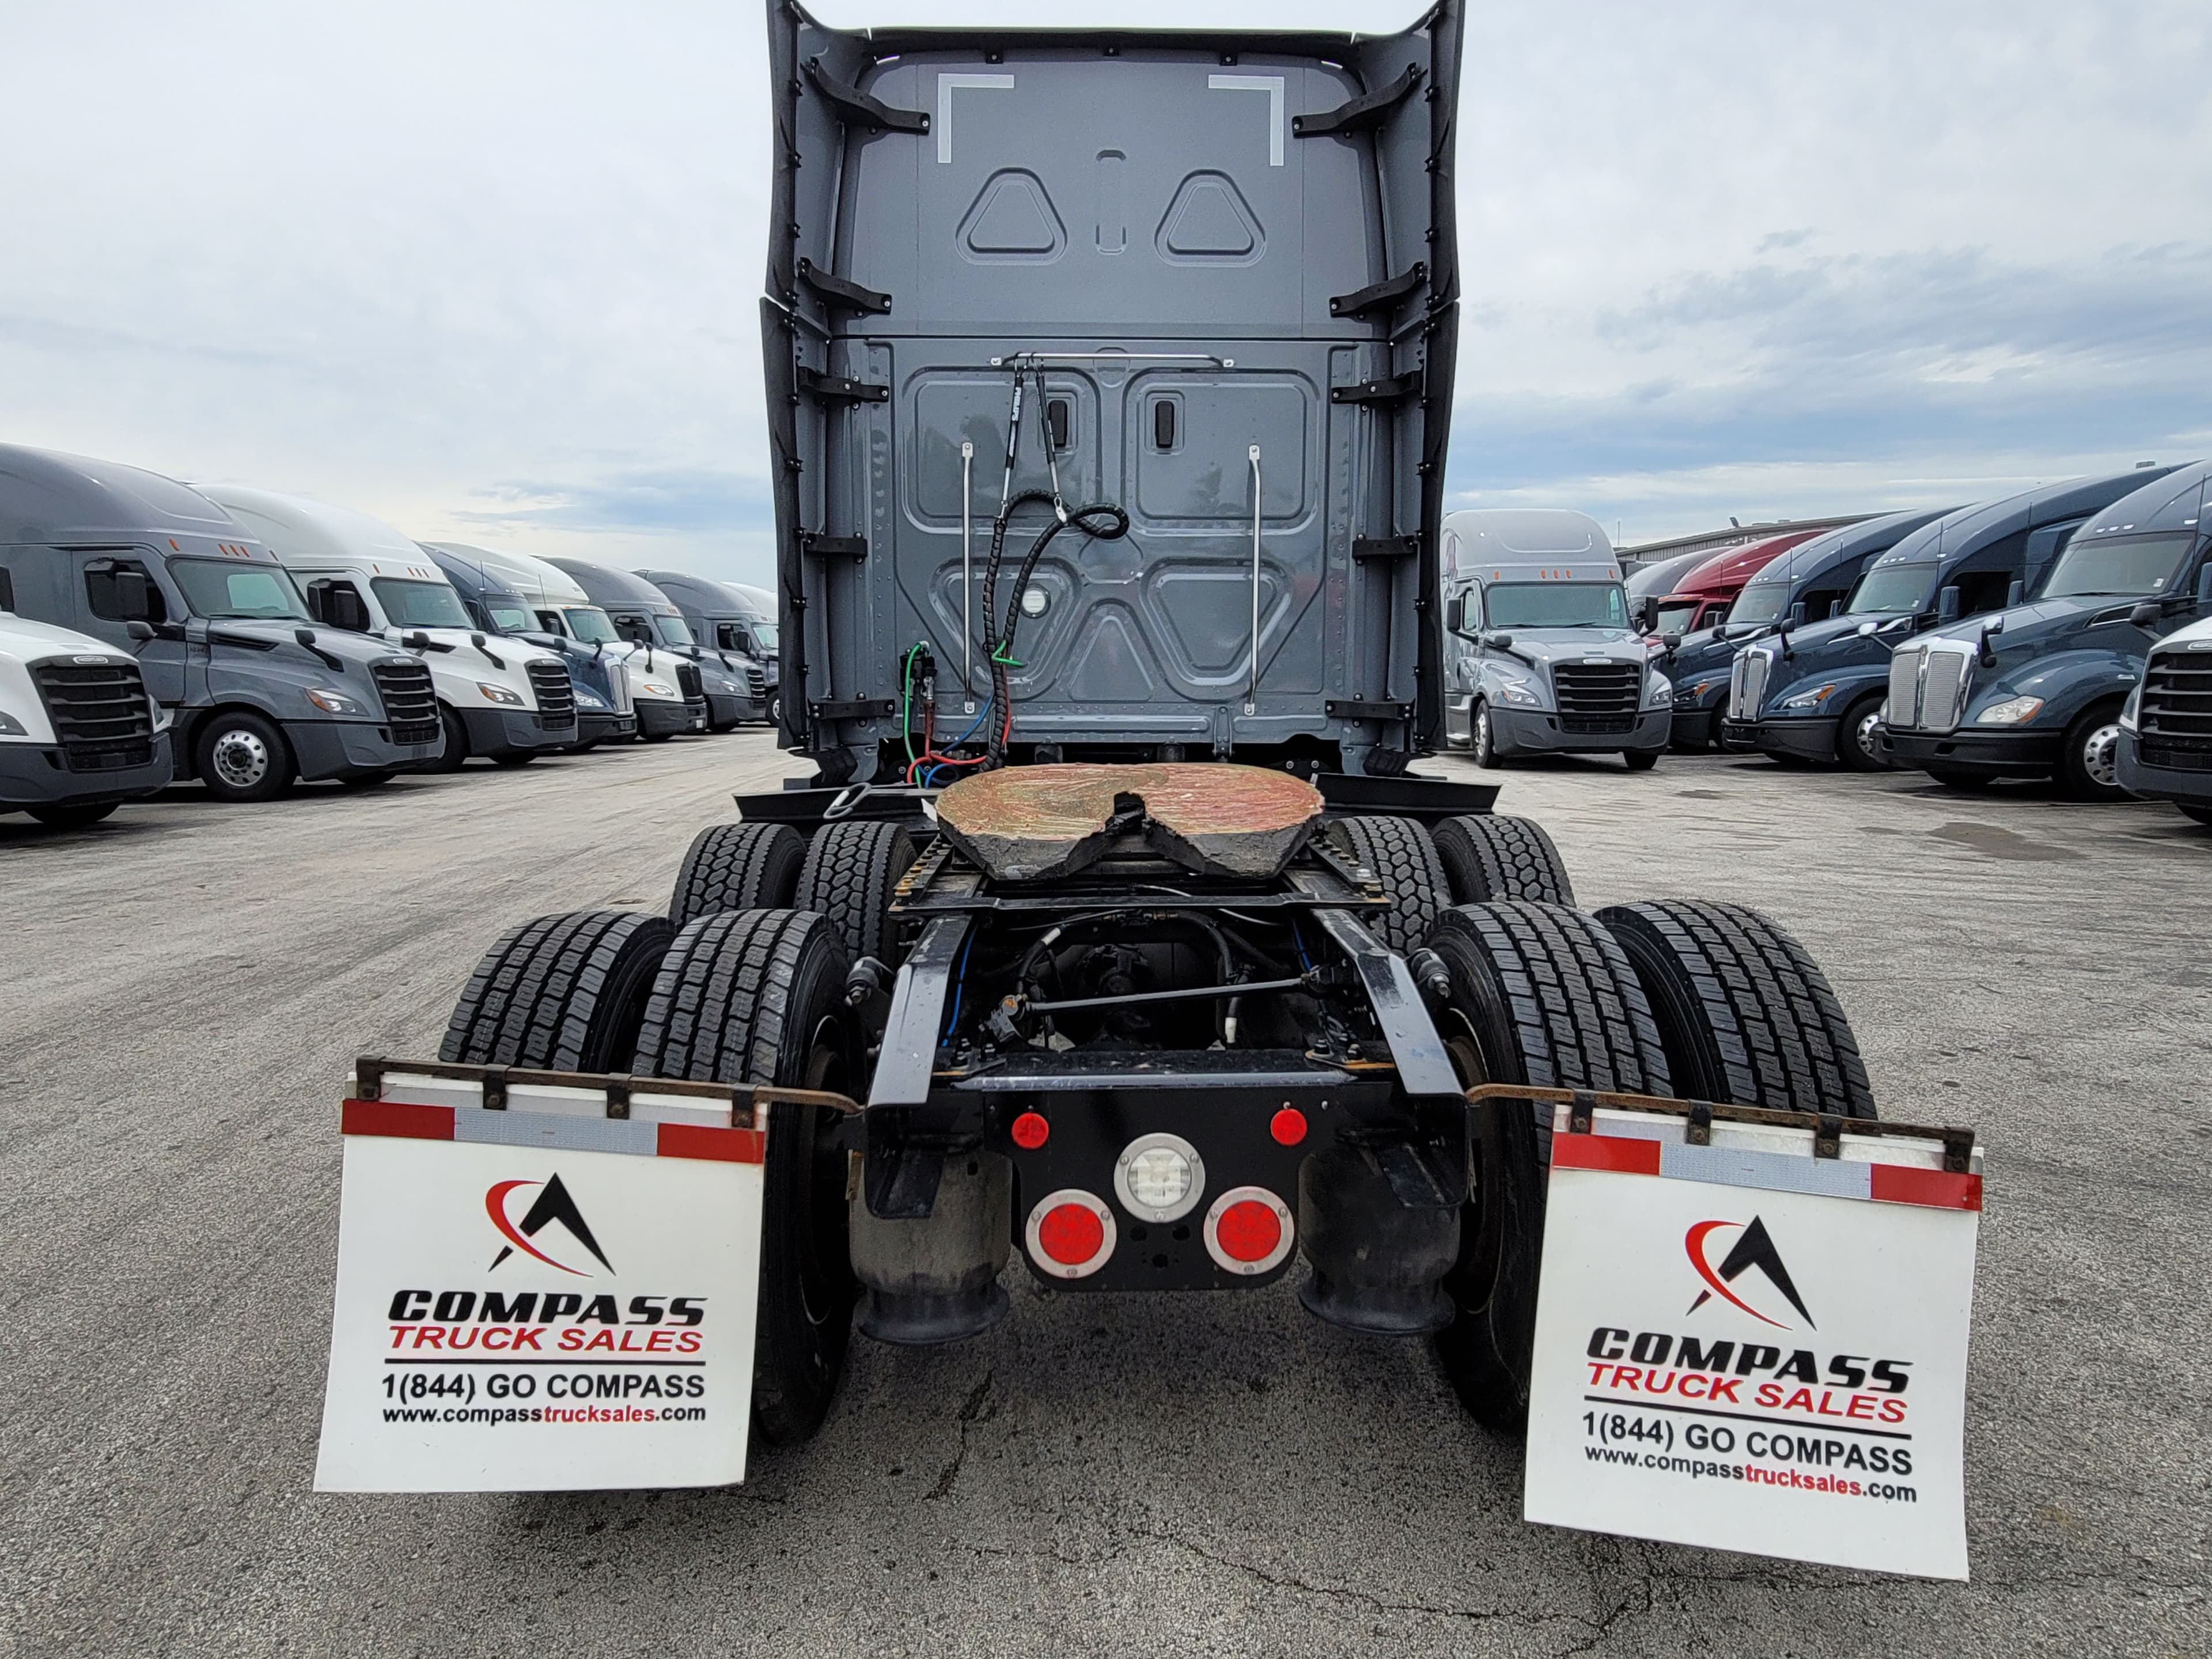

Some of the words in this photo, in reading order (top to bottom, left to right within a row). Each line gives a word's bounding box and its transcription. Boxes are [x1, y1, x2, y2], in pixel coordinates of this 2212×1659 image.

[388, 1290, 708, 1327] COMPASS
[389, 1325, 547, 1351] TRUCK
[557, 1328, 703, 1353] SALES
[1586, 1327, 1913, 1393] COMPASS
[382, 1373, 476, 1405] 1(844)
[487, 1373, 536, 1399] GO
[547, 1374, 704, 1399] COMPASS
[1588, 1362, 1743, 1403] TRUCK
[1754, 1384, 1907, 1423] SALES
[382, 1404, 706, 1427] www.compasstrucksales.com
[1583, 1411, 1674, 1452] 1(844)
[1685, 1423, 1735, 1453] GO
[1747, 1431, 1912, 1476] COMPASS
[1585, 1446, 1917, 1503] www.compasstrucksales.com
